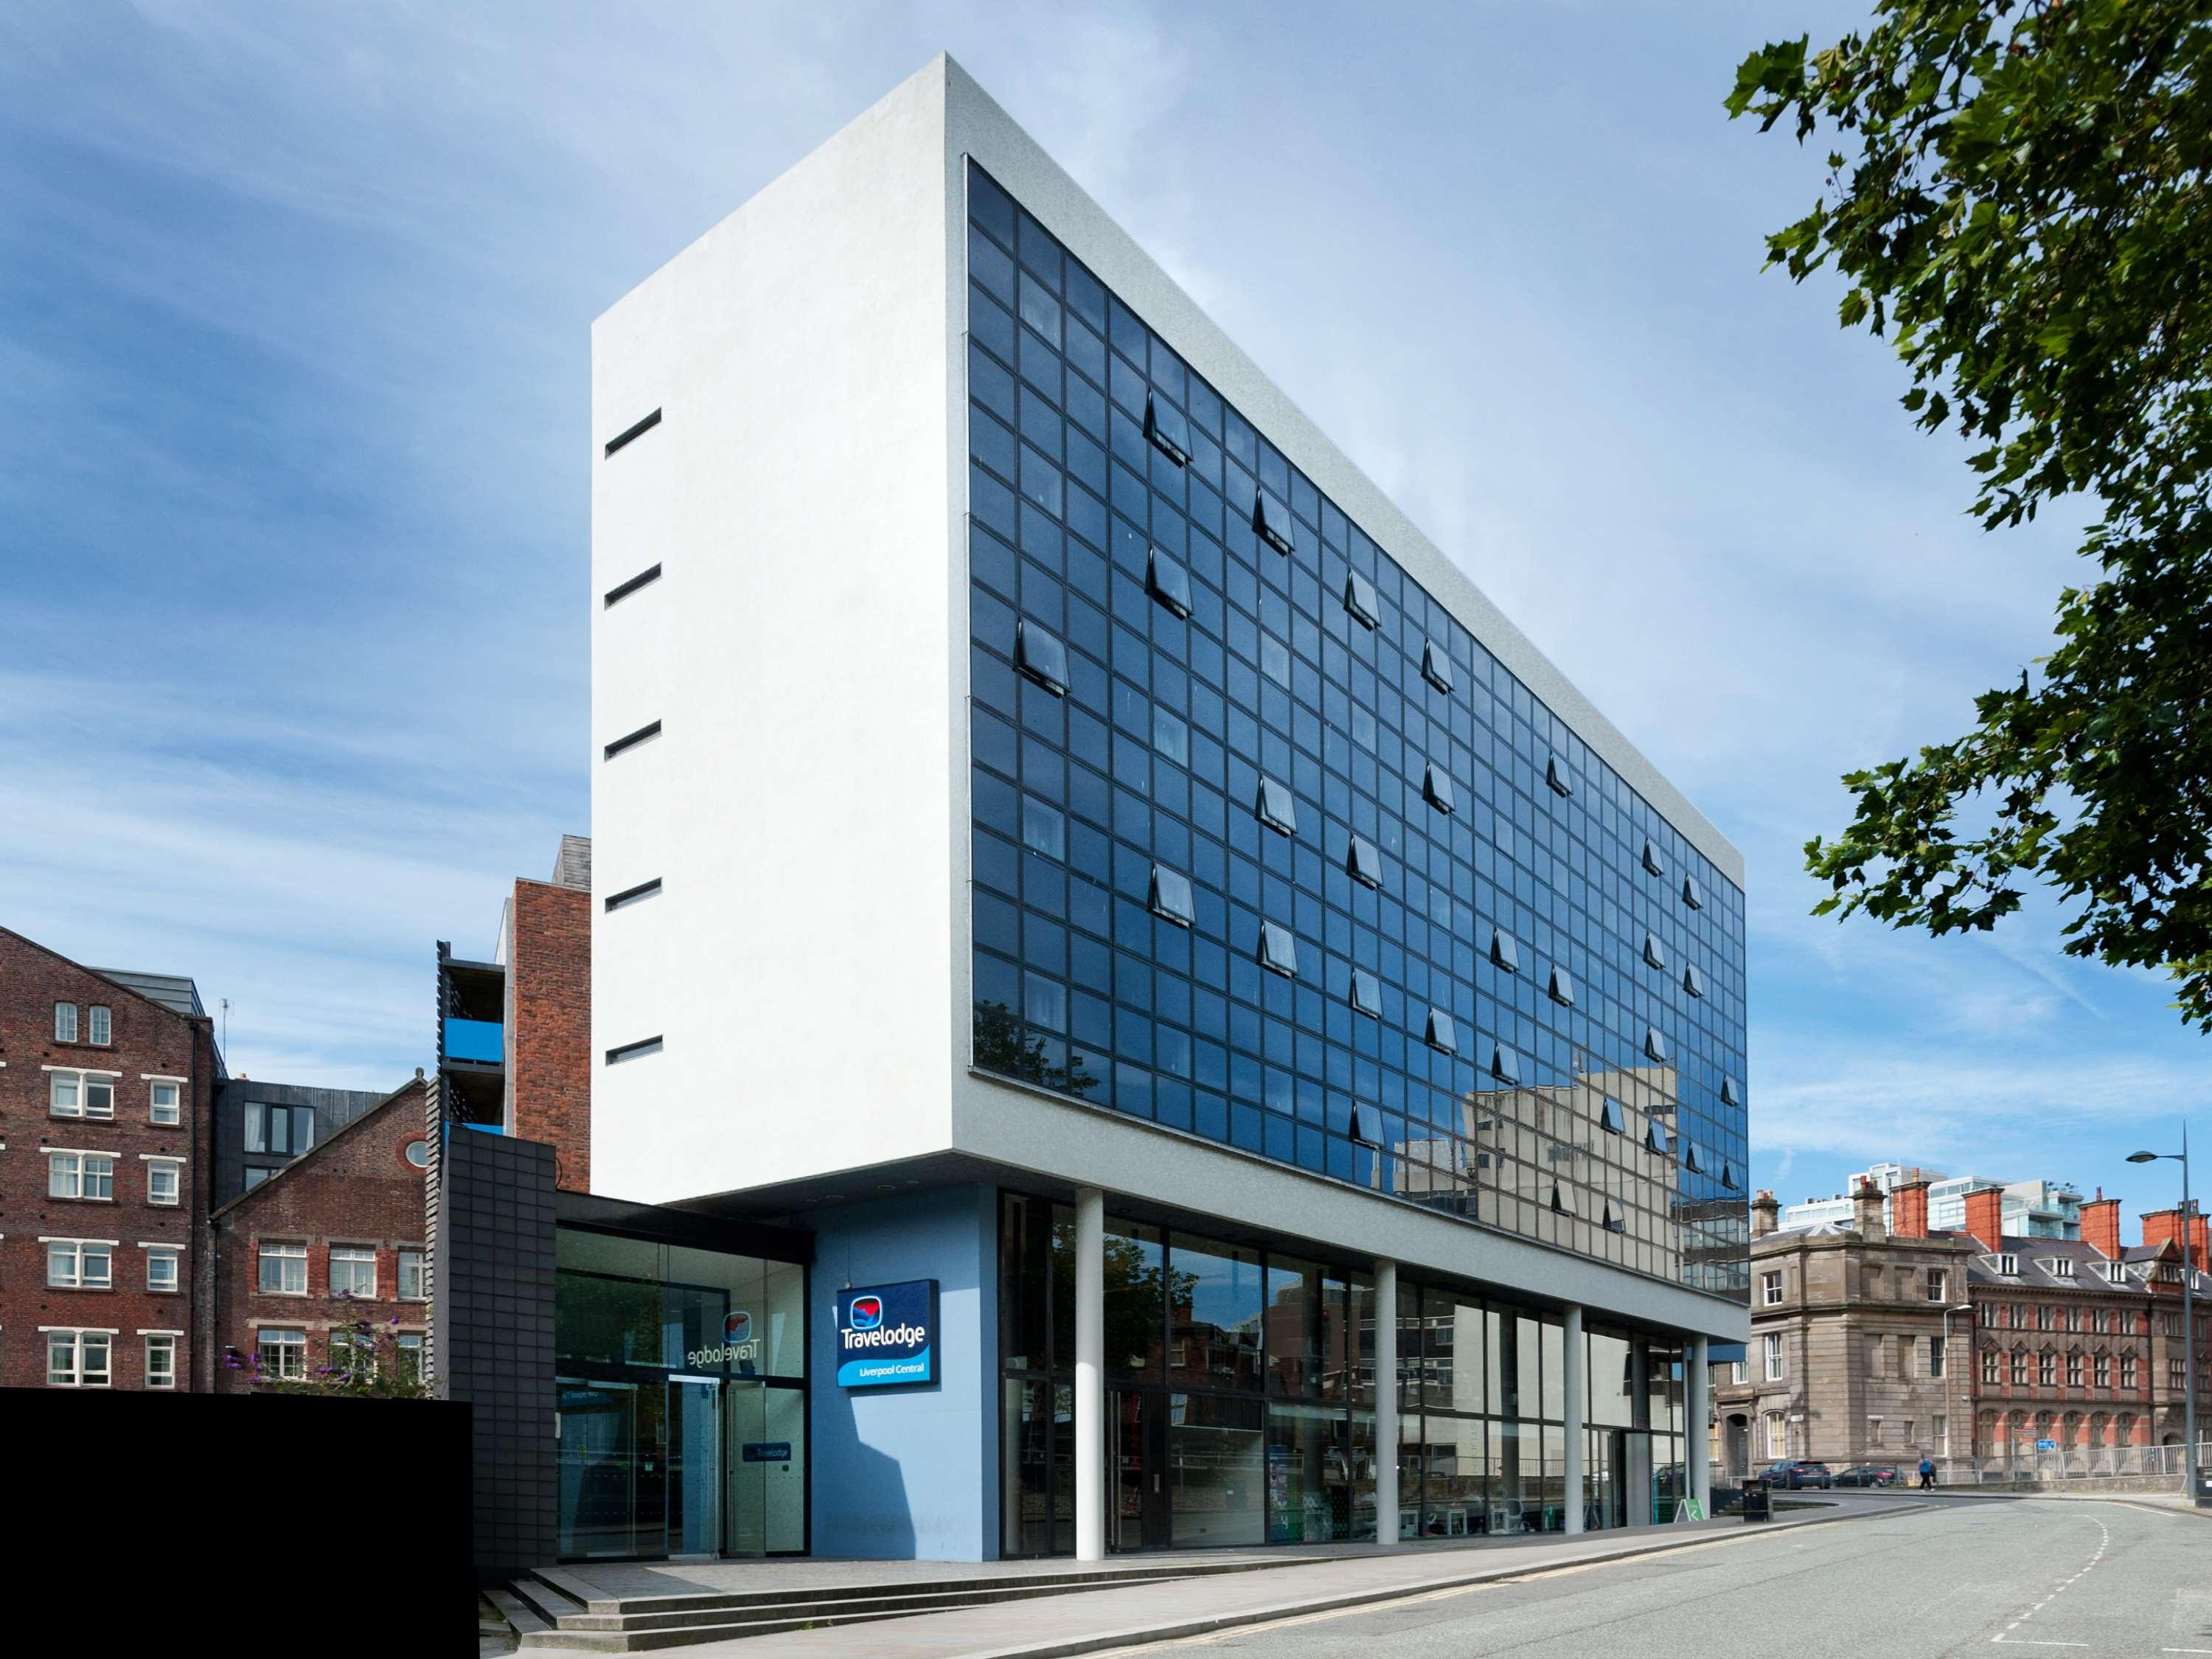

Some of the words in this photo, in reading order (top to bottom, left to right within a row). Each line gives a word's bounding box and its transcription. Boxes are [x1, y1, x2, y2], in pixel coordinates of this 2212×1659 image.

[841, 1322, 925, 1349] Travelodge
[859, 1365, 895, 1377] Liverpool
[896, 1363, 925, 1374] Central
